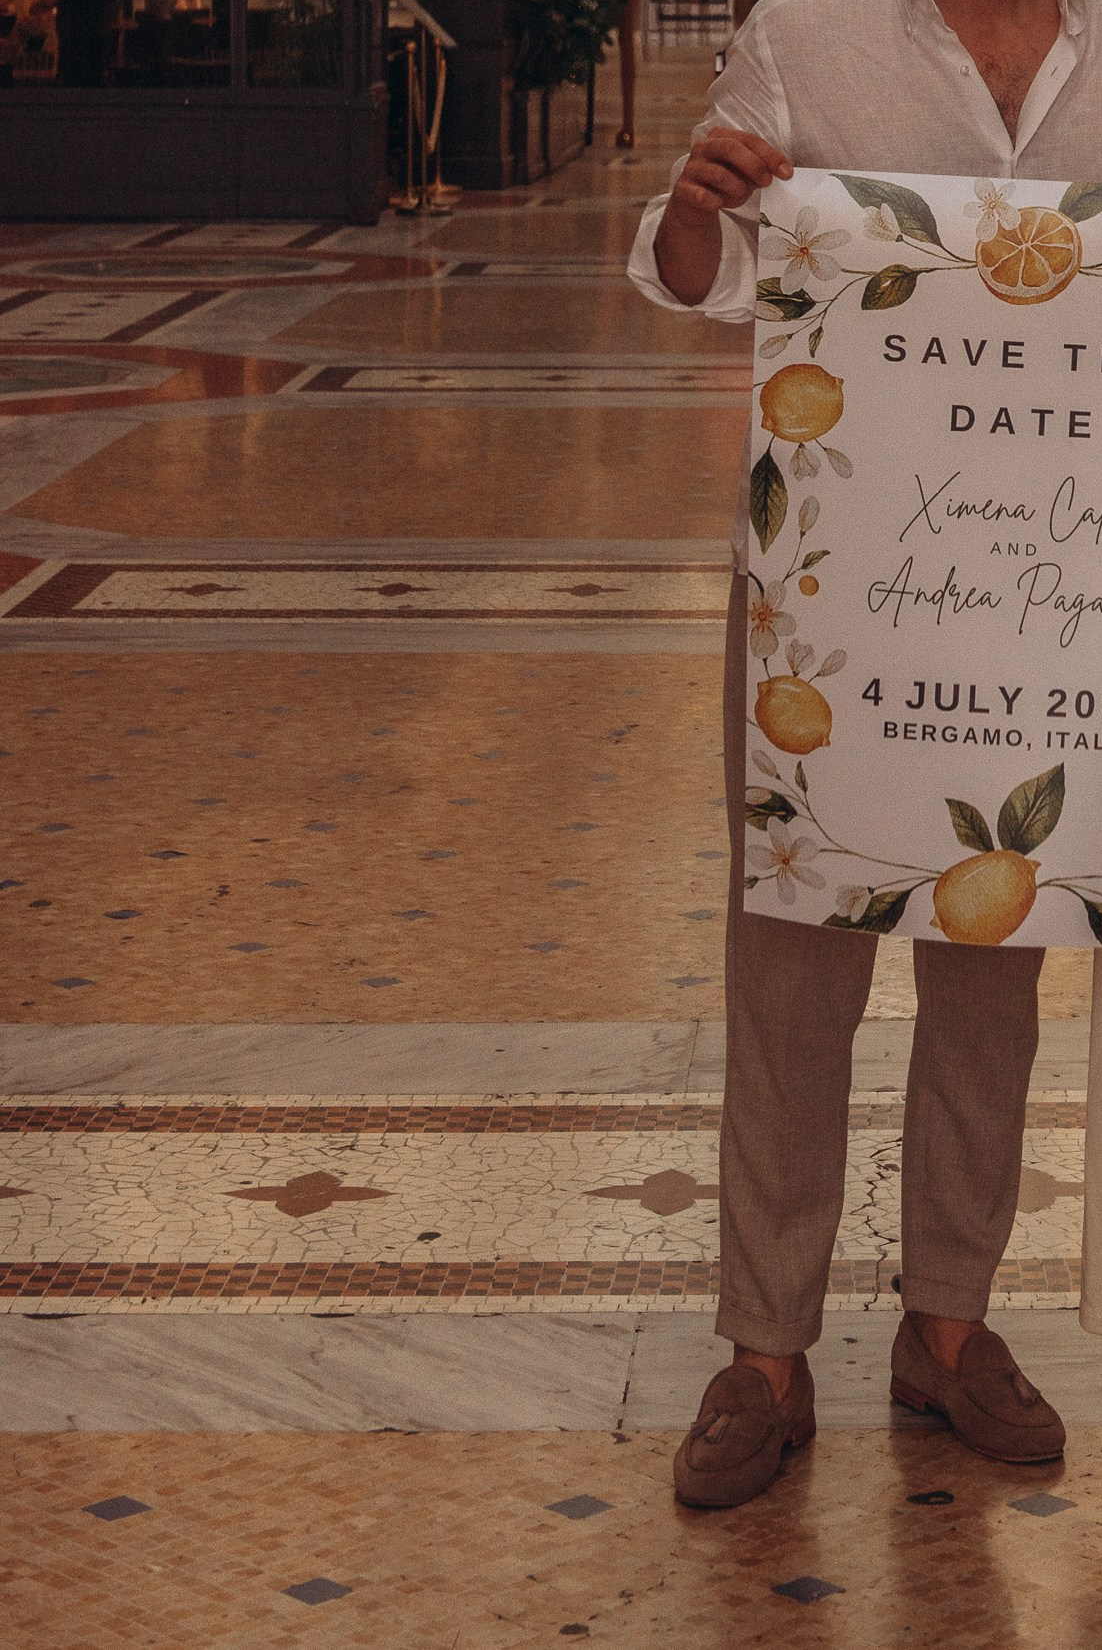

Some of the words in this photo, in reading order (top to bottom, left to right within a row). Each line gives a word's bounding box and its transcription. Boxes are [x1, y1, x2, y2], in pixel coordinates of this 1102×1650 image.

[883, 333, 1025, 370] SAVE
[950, 403, 1092, 439] DATE
[898, 470, 1036, 543] Ximena
[991, 541, 1038, 557] AND
[867, 555, 1002, 629] Andrea
[861, 677, 884, 707] 4
[904, 680, 1023, 716] JULY
[883, 720, 1032, 750] BERGAMO,
